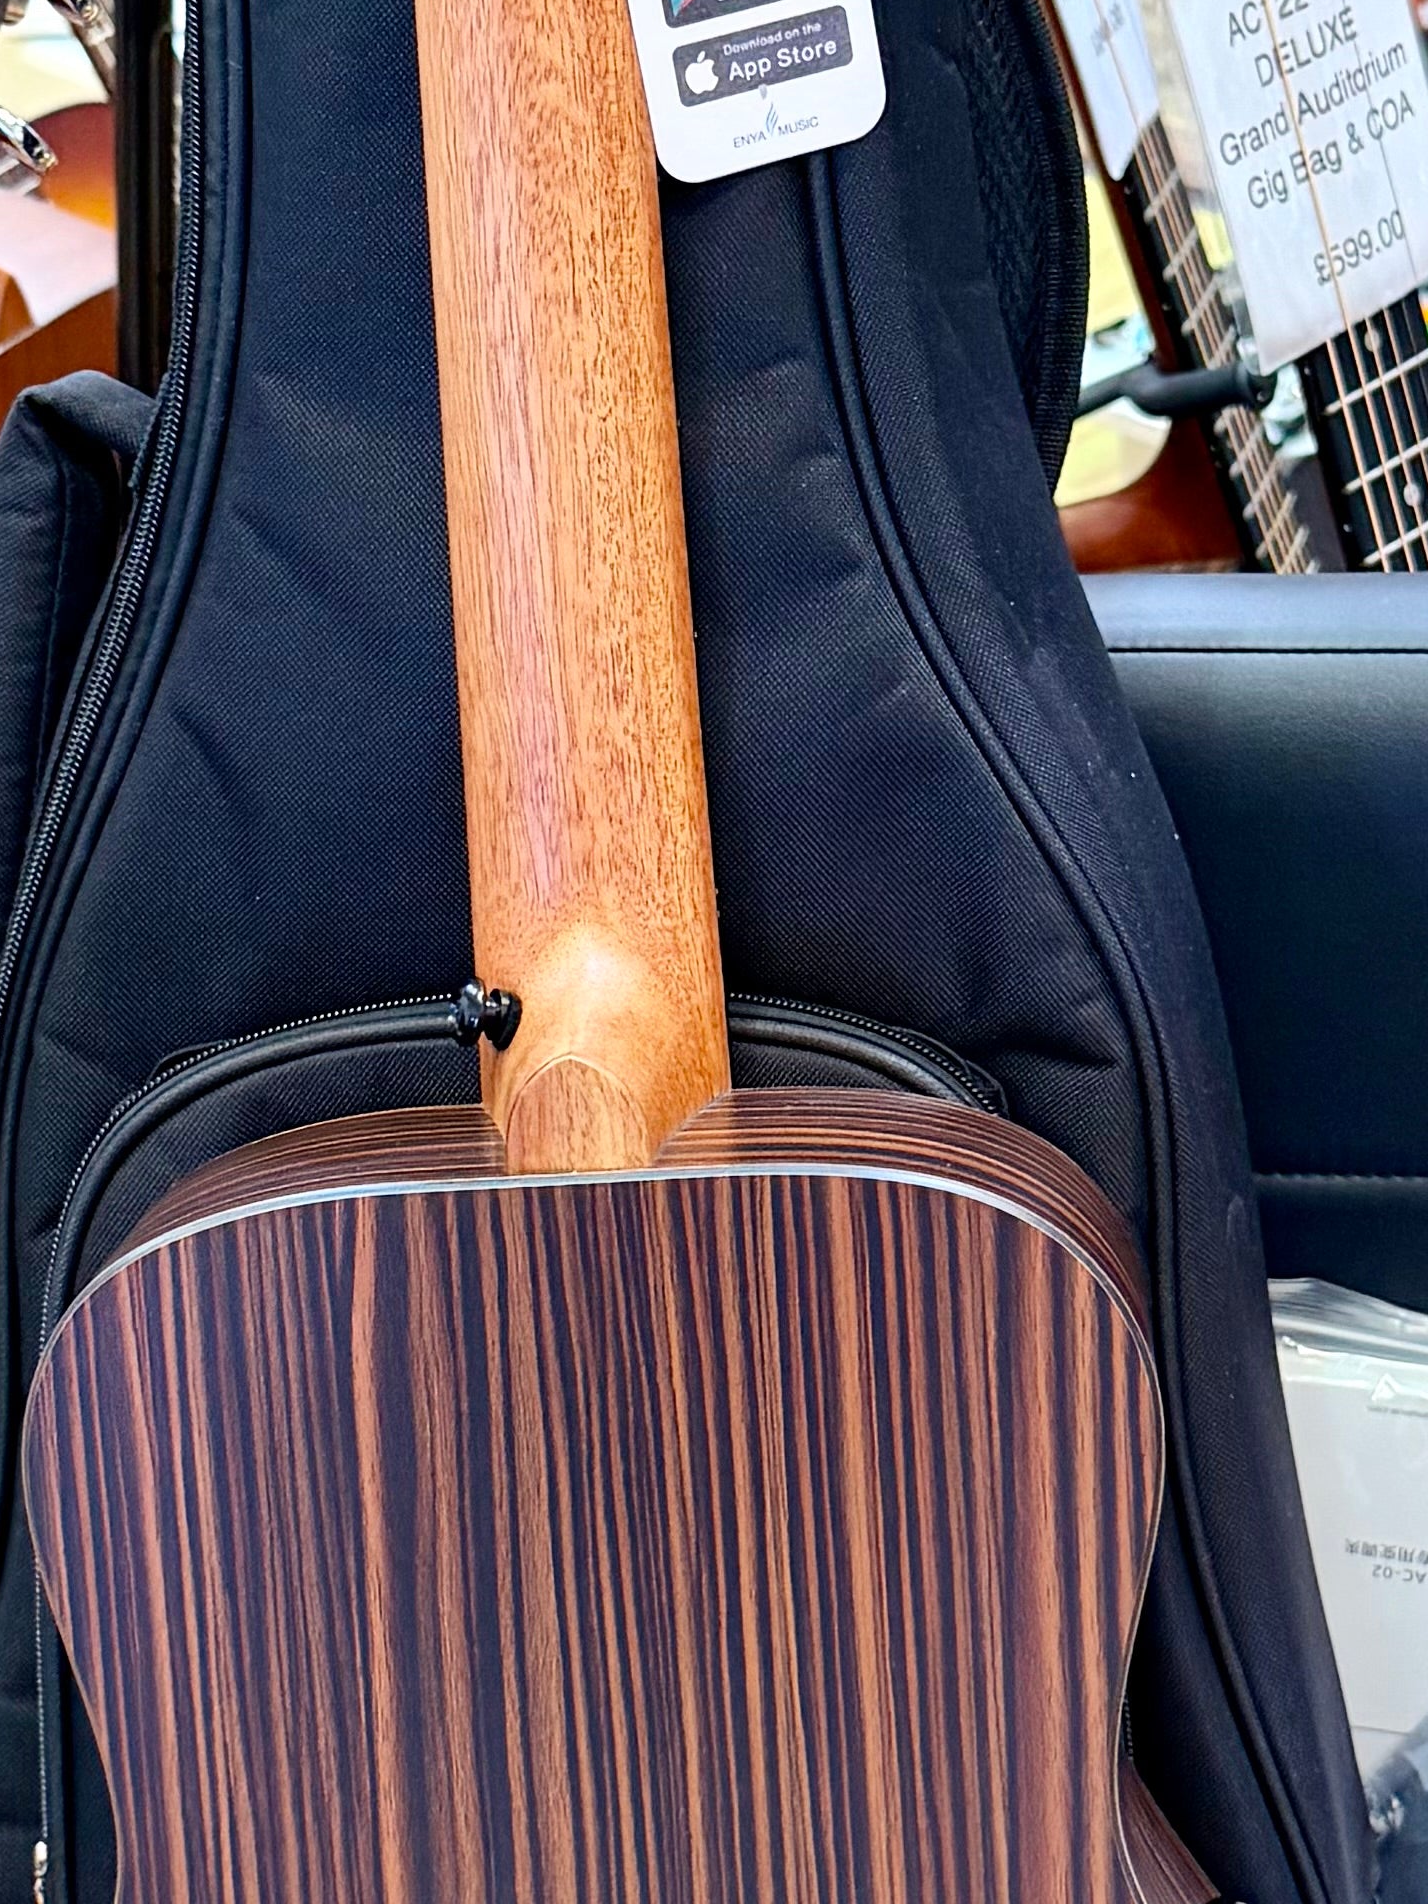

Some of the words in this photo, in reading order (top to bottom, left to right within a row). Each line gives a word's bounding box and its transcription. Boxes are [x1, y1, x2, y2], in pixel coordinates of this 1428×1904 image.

[723, 29, 783, 57] Download
[785, 26, 800, 40] on
[802, 21, 822, 38] the
[729, 56, 772, 82] App
[776, 39, 837, 68] Store
[1255, 5, 1359, 88] DELUXE
[733, 129, 767, 149] ENYA
[778, 115, 820, 137] MUSIC
[1219, 101, 1290, 167] Grand
[1296, 41, 1408, 127] Auditorium
[1247, 168, 1289, 209] Gig
[1289, 140, 1343, 188] Bag
[1347, 121, 1365, 154] &
[1366, 90, 1416, 142] COA
